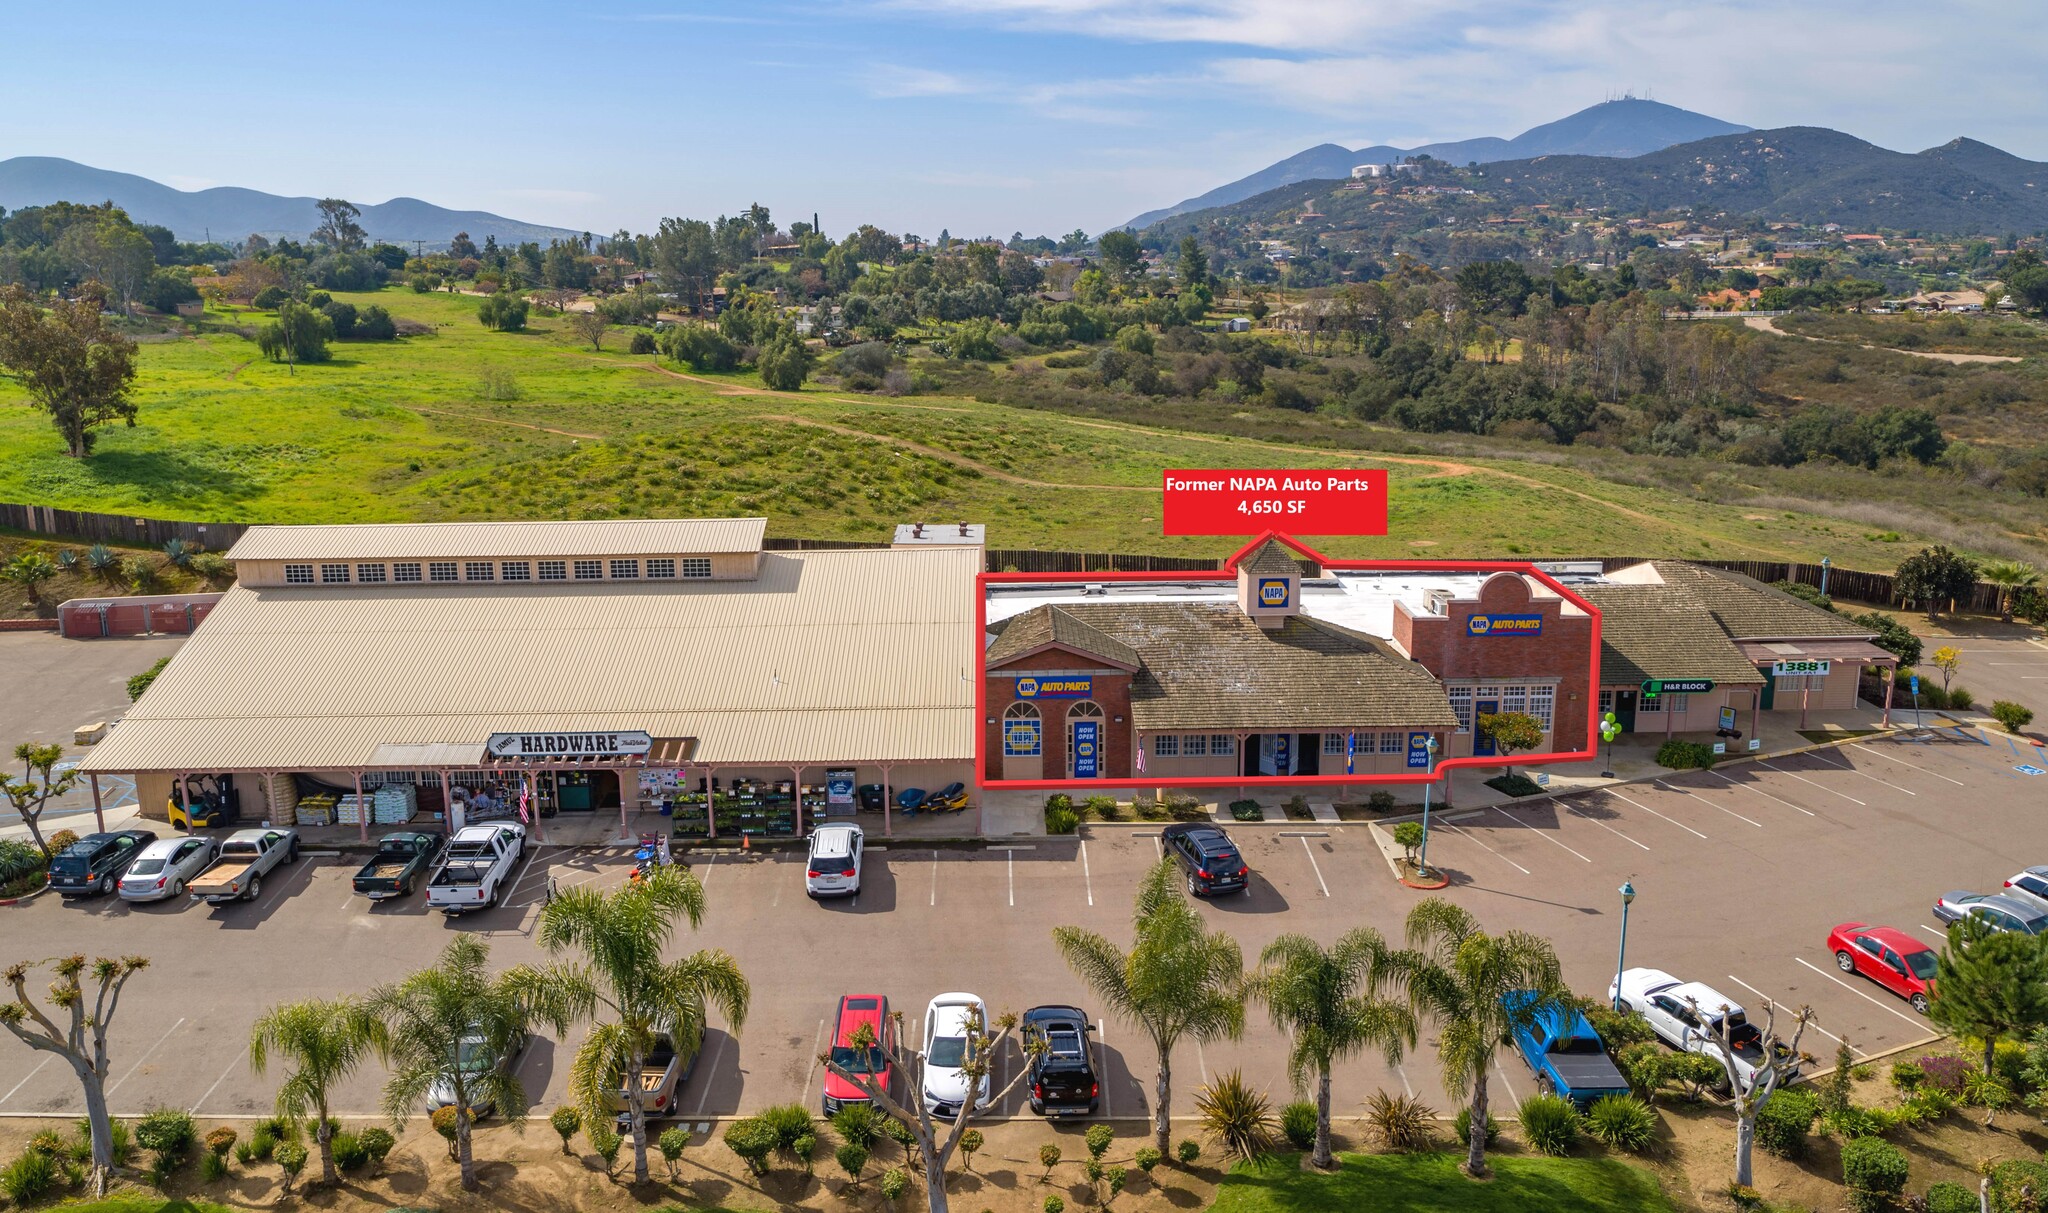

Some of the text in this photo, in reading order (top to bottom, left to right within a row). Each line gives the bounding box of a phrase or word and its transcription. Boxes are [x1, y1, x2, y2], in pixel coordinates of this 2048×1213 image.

[1264, 587, 1284, 599] NAPA
[1472, 620, 1541, 629] NAPA AUTO PARTS
[1776, 662, 1829, 672] 13881
[1020, 682, 1090, 692] NAPA AUTO PARTS
[520, 734, 619, 753] HARDWARE
